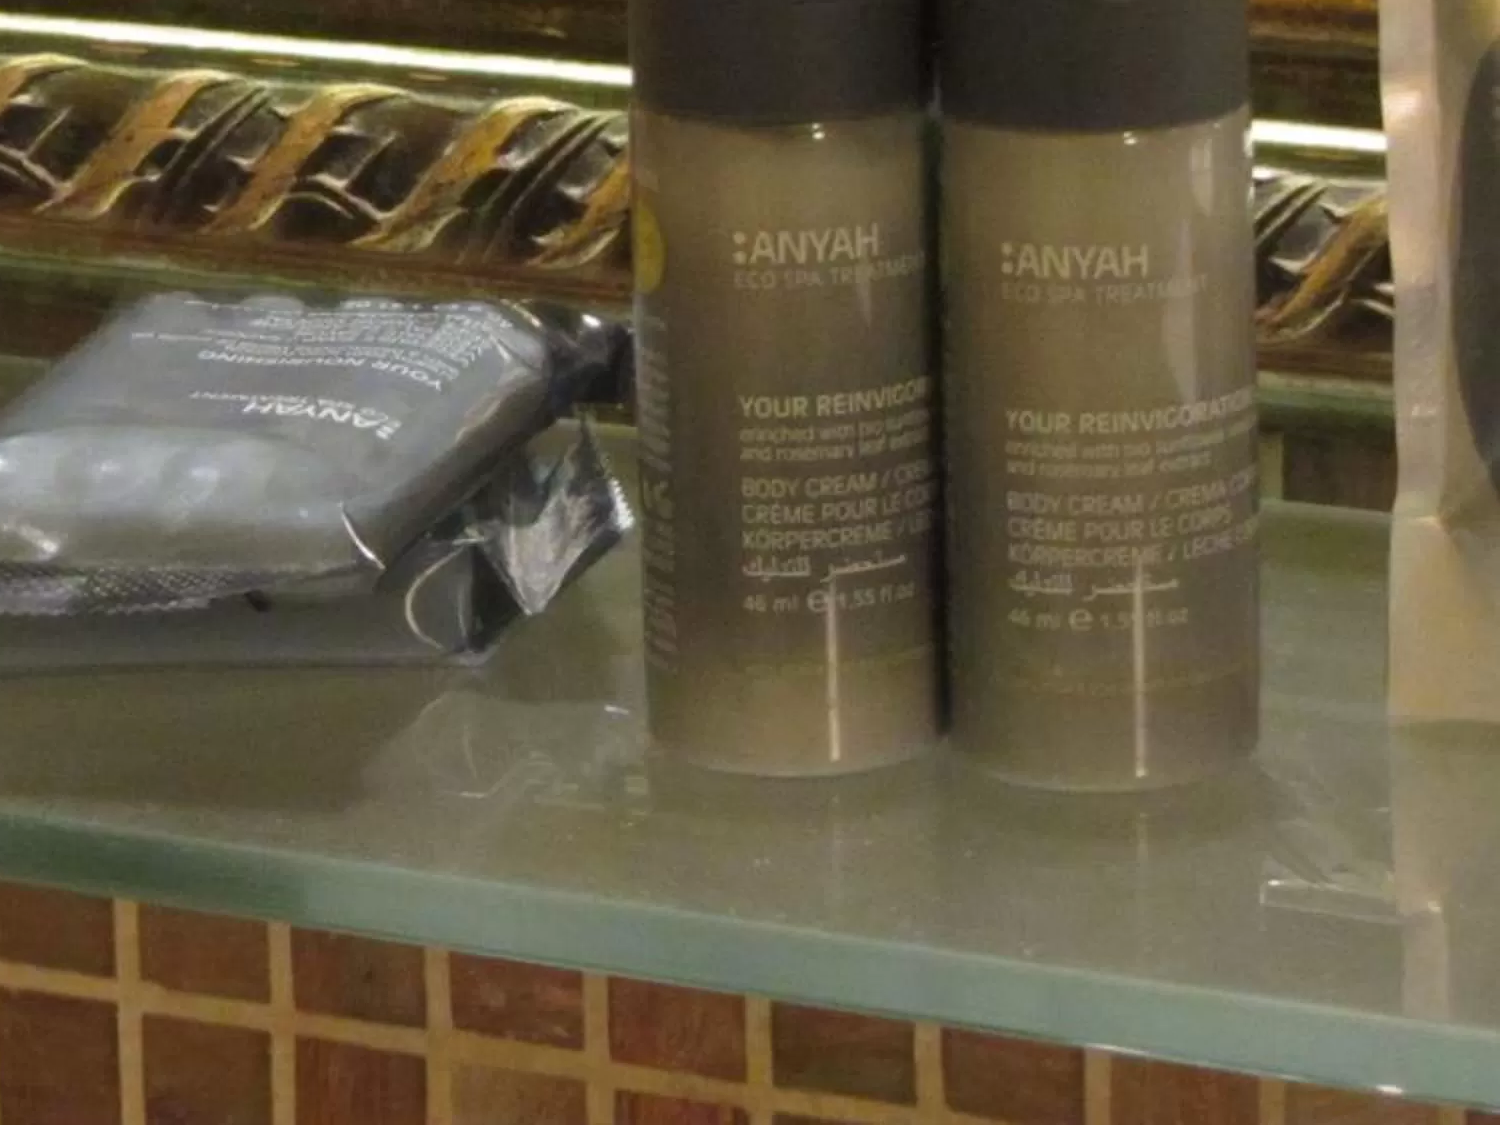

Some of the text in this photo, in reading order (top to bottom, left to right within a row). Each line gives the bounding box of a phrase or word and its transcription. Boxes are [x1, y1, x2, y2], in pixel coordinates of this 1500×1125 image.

[739, 394, 809, 419] YOUR
[1005, 409, 1072, 435] YOUR
[741, 477, 802, 499] BODY
[804, 471, 877, 499] CREAM
[821, 496, 878, 522] POUR
[882, 491, 901, 515] LE
[1005, 490, 1061, 514] BODY
[1067, 492, 1145, 515] CREAM
[1083, 518, 1145, 542] POUR
[1149, 515, 1174, 539] LE
